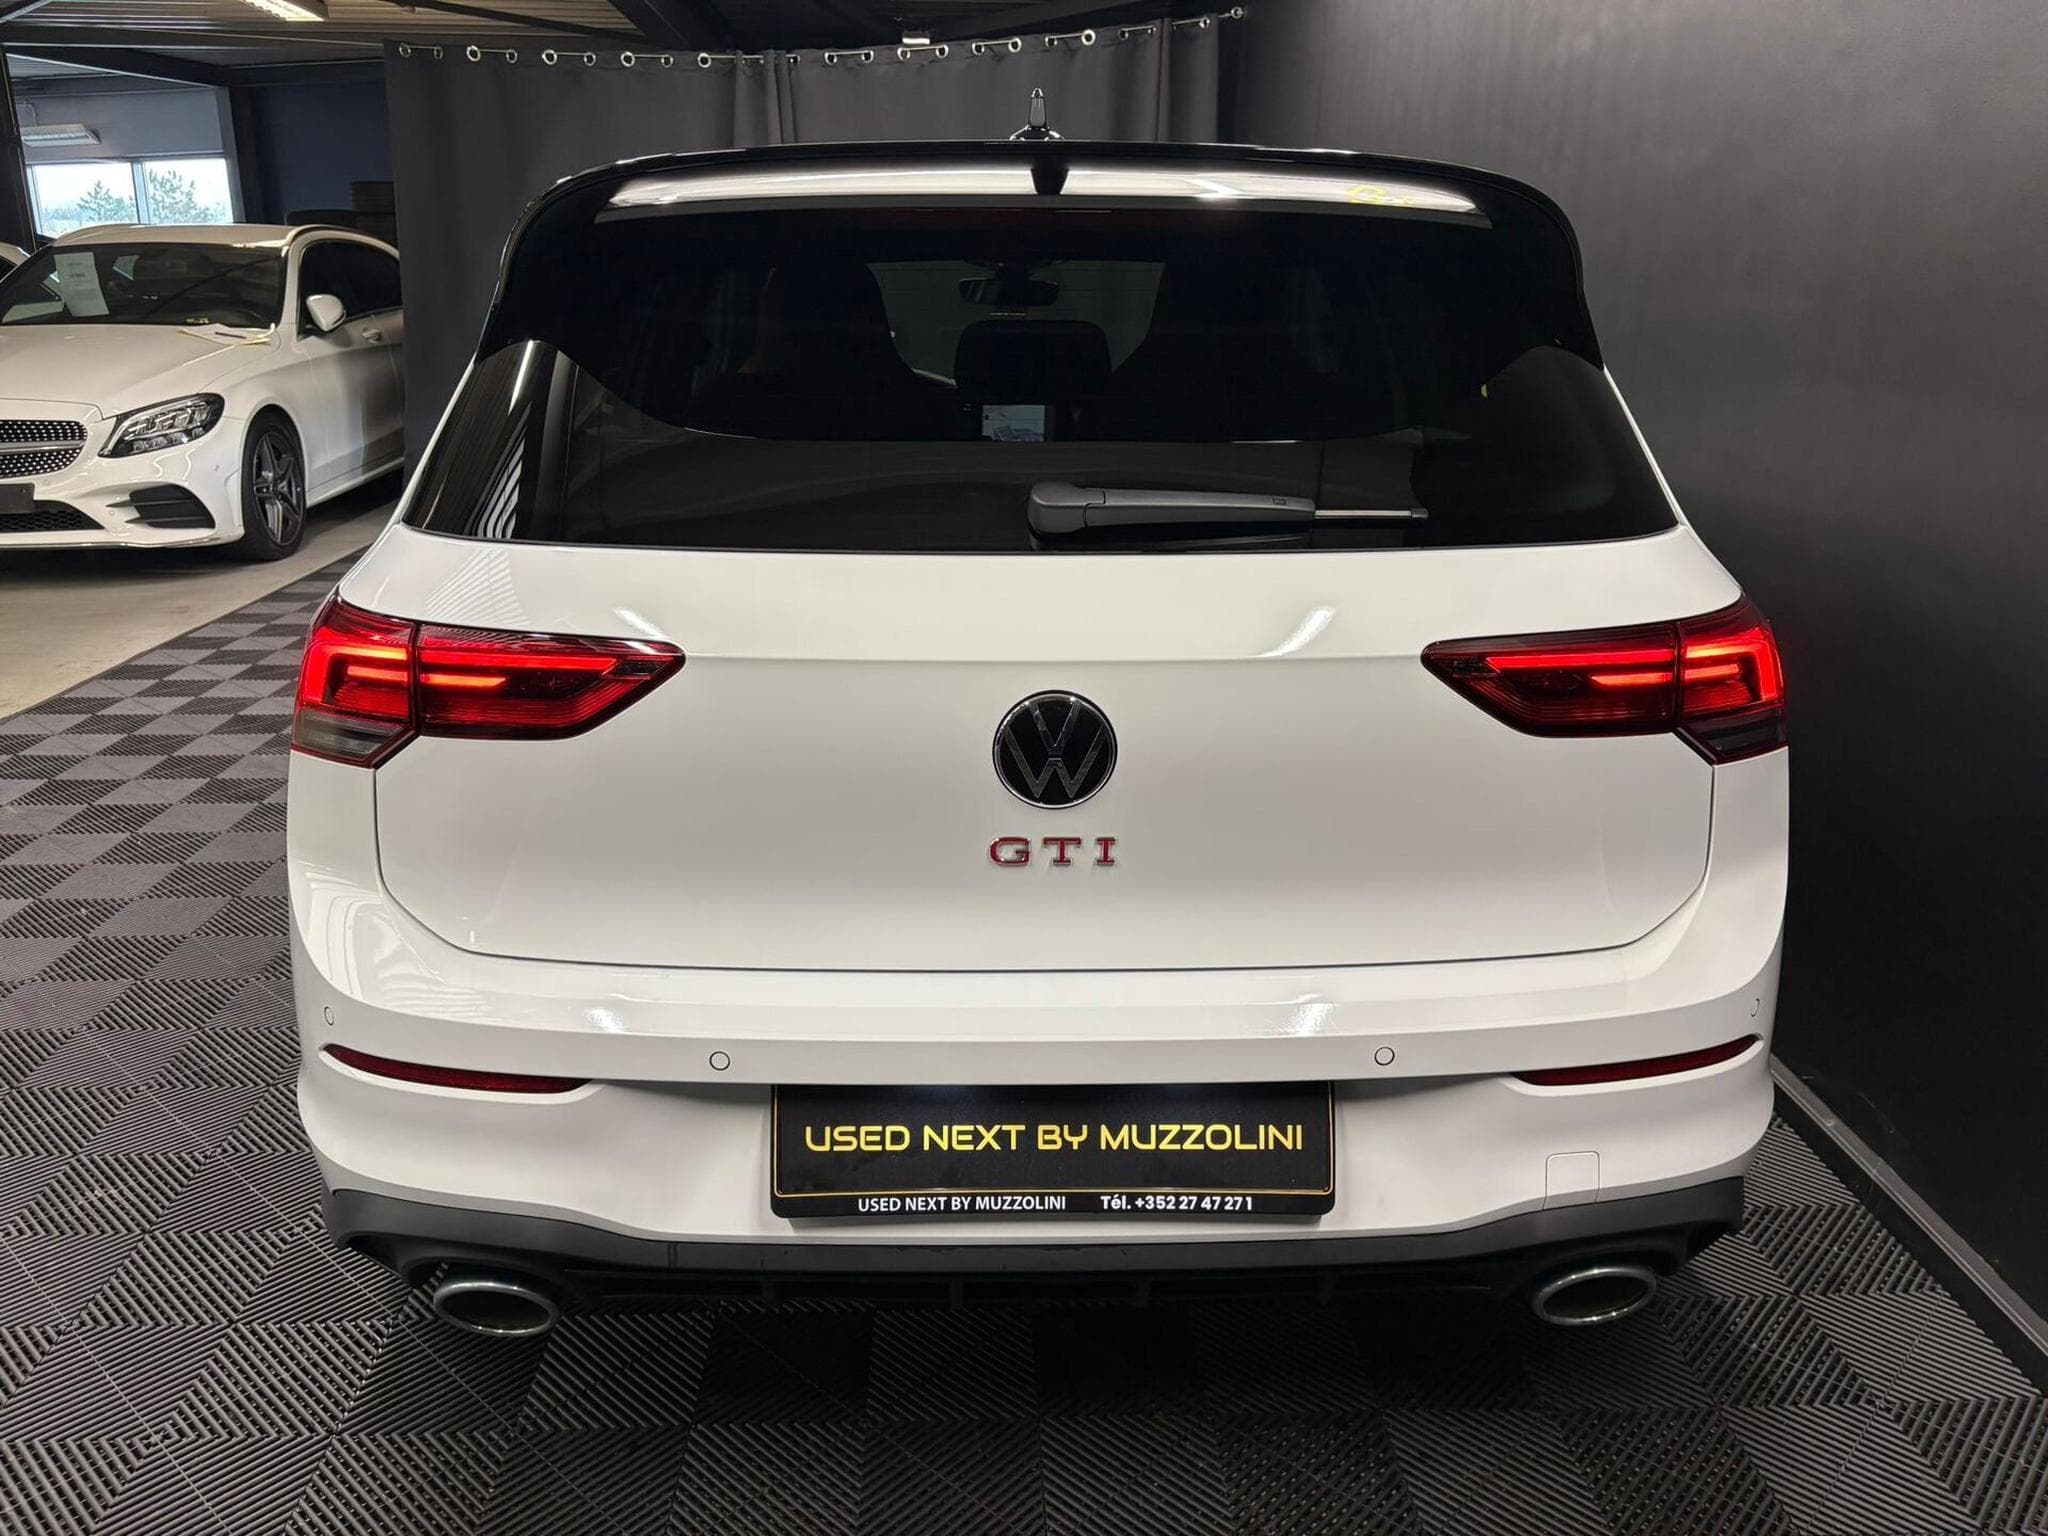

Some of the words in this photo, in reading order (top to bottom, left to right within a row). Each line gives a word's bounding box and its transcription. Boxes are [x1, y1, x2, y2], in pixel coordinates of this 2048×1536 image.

[989, 836, 1117, 867] GTI
[805, 1125, 911, 1152] USED
[923, 1124, 1026, 1151] NEXT
[1037, 1124, 1088, 1151] BY
[1100, 1124, 1303, 1150] MUZZOLINI
[858, 1197, 901, 1212] USED
[905, 1197, 948, 1211] NEXT
[951, 1197, 971, 1211] BY
[975, 1196, 1066, 1211] MUZZOLINI
[1100, 1194, 1132, 1210] Tél.
[1135, 1195, 1176, 1210] +352
[1178, 1196, 1198, 1210] 27
[1200, 1196, 1221, 1210] 47
[1223, 1196, 1253, 1211] 271
